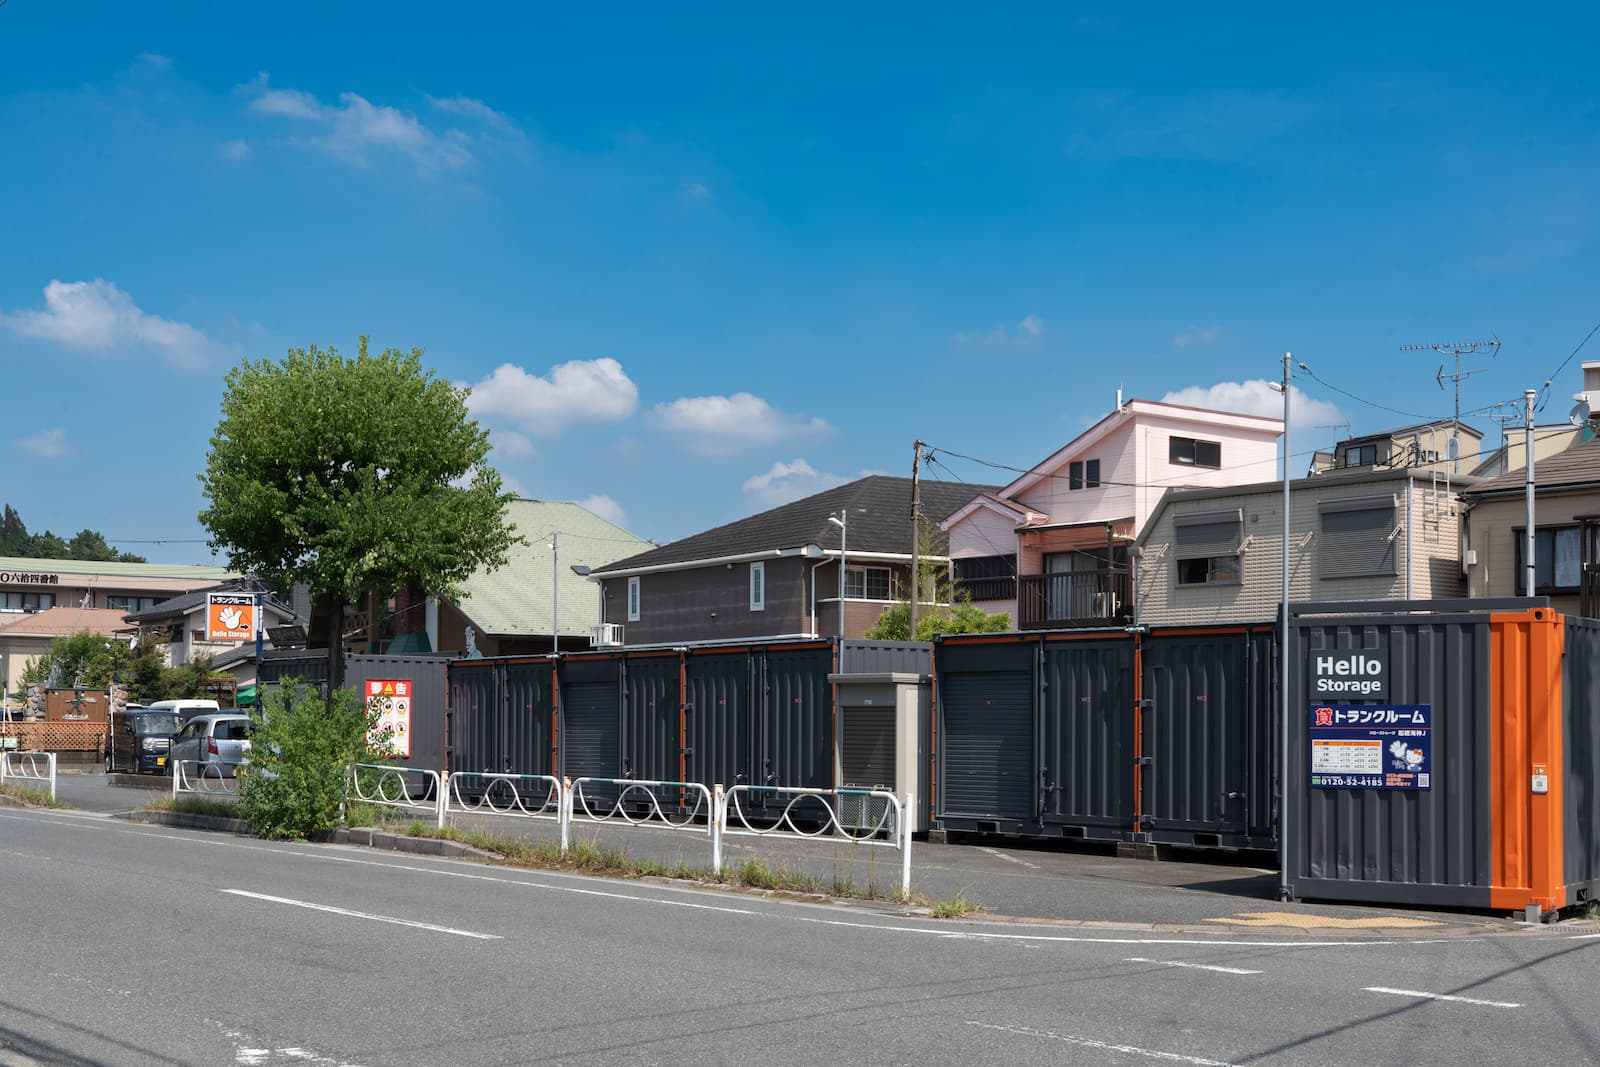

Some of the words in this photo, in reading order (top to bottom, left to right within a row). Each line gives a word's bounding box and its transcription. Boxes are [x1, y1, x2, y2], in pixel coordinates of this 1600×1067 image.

[211, 596, 251, 605] トランクルーム
[1316, 655, 1382, 676] Hello
[1316, 678, 1382, 694] Storage
